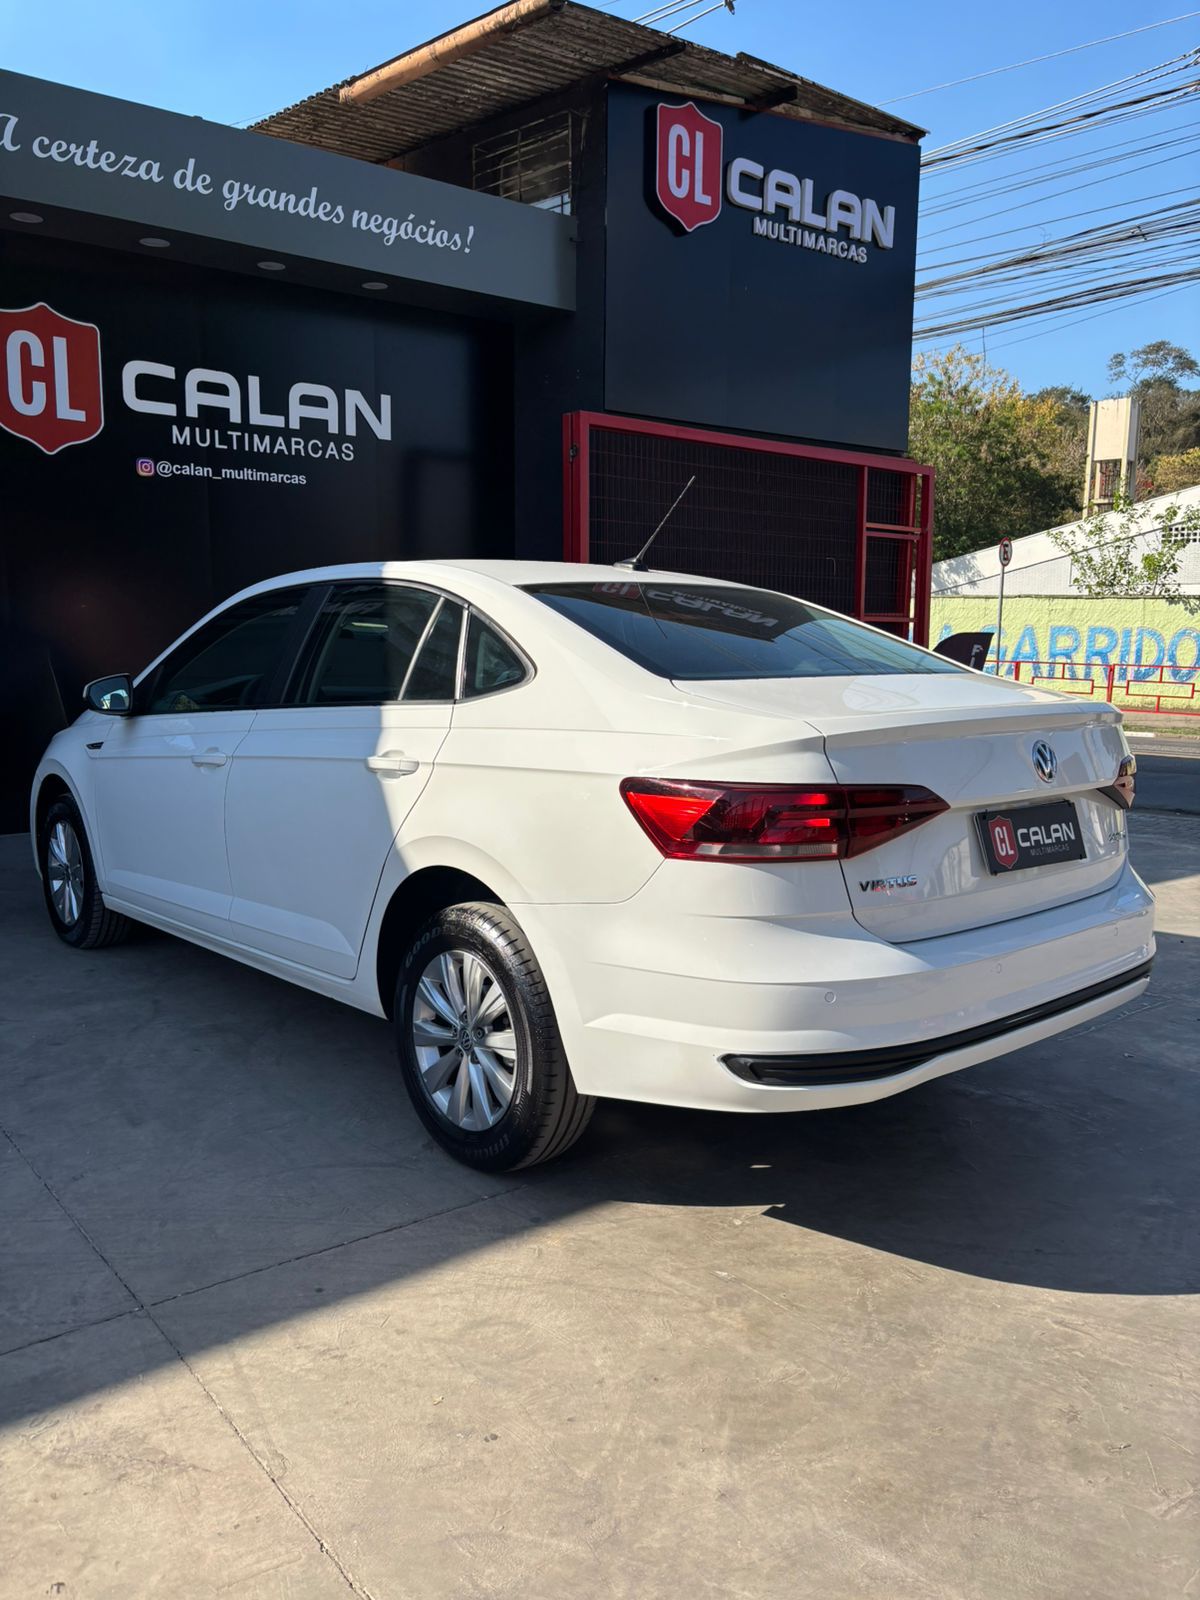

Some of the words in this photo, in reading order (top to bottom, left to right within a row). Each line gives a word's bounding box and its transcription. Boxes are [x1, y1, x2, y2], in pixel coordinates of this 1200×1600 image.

[667, 123, 712, 206] CL
[32, 135, 164, 183] certeza
[173, 159, 214, 195] de
[222, 178, 346, 224] grandes
[351, 209, 475, 254] negócios!
[726, 157, 896, 249] CALAN
[753, 216, 867, 263] MULTIMARCAS
[6, 329, 87, 423] CL
[122, 360, 393, 441] CALAN
[172, 424, 355, 462] MULTIMARCAS
[156, 460, 307, 485] @calan_multimarcas
[995, 826, 1015, 857] CL
[1017, 822, 1076, 848] CALAN
[859, 874, 918, 892] VIRTUS
